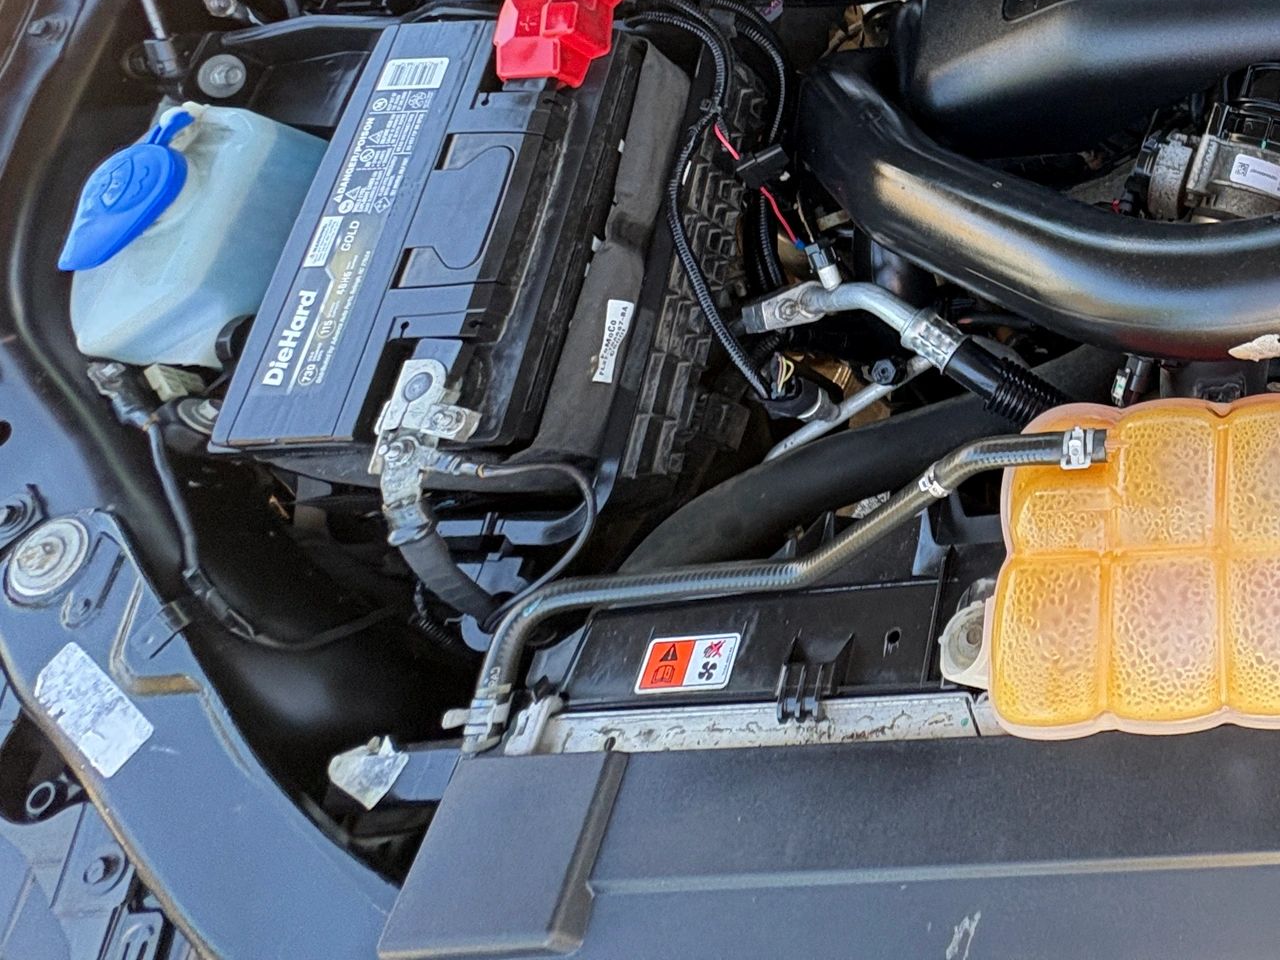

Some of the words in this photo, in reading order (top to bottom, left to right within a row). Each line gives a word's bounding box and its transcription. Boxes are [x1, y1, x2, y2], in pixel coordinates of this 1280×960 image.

[337, 117, 376, 196] DANGER/POISON
[340, 220, 360, 252] GOLD
[262, 290, 318, 386] DieHard
[320, 320, 333, 335] 115
[601, 320, 617, 359] FoMoCo
[301, 363, 316, 382] 730
